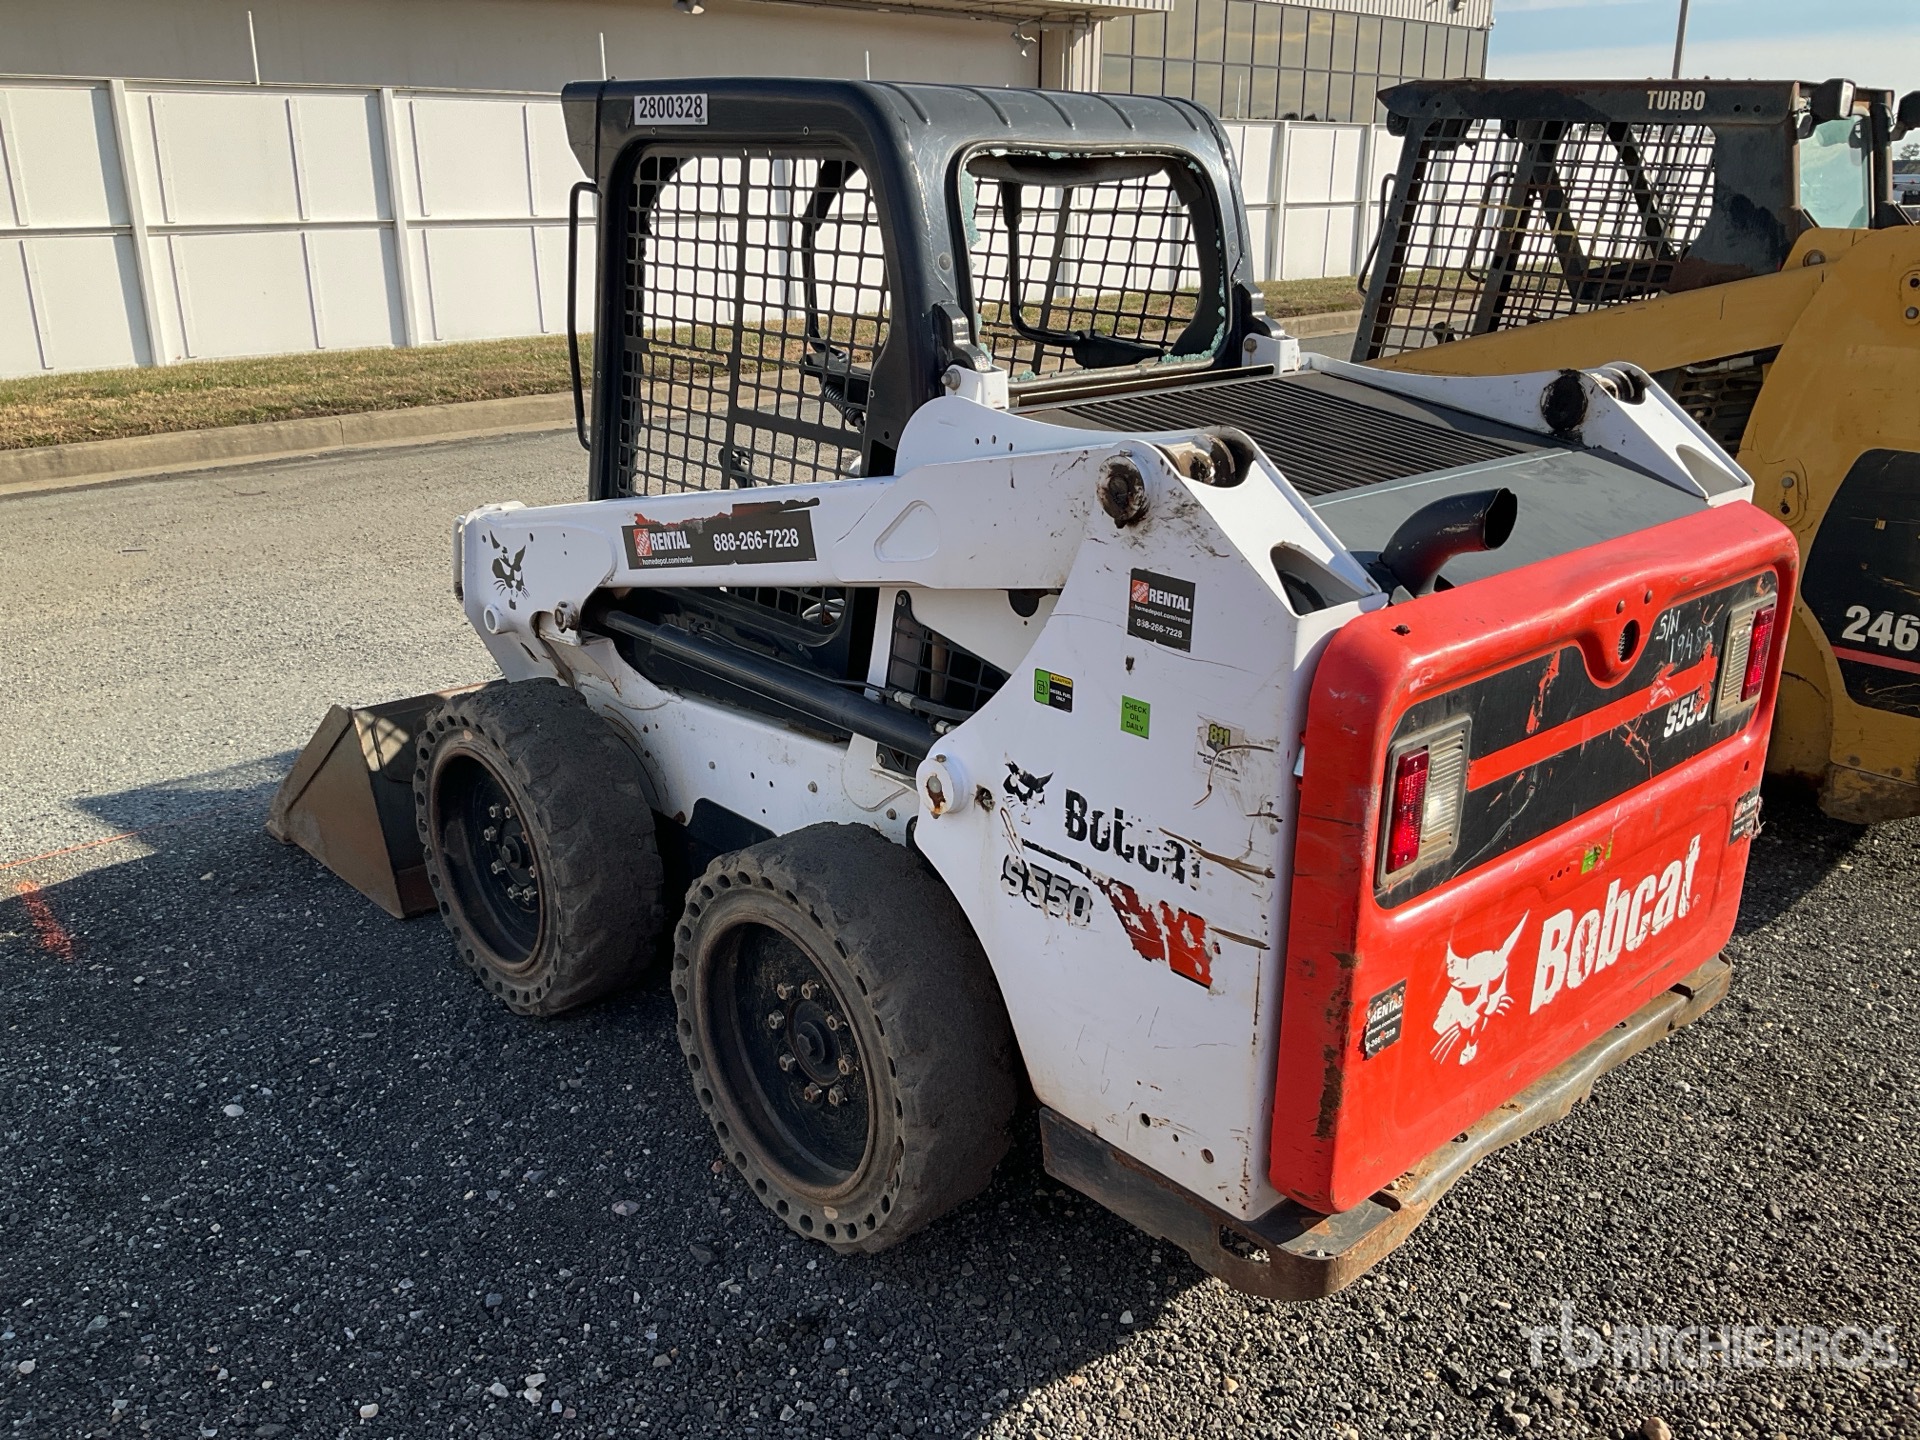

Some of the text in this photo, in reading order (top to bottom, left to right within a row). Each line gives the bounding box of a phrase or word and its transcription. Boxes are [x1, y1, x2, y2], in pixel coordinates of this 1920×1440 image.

[639, 95, 703, 119] 2800328
[1647, 90, 1706, 111] TURBO
[649, 528, 799, 552] RENTAL 888-266-7228
[642, 556, 694, 566] homedepot.com/rental
[1149, 588, 1191, 612] RENTAL
[1134, 604, 1191, 625] homedepot.com/rental
[1656, 608, 1681, 641] S/N
[1842, 605, 1920, 651] 246
[1124, 702, 1147, 715] CHECK
[1130, 713, 1141, 722] OIL
[1126, 721, 1144, 732] DAILY
[1001, 854, 1094, 929] S550
[1529, 833, 1702, 1016] Bobcat
